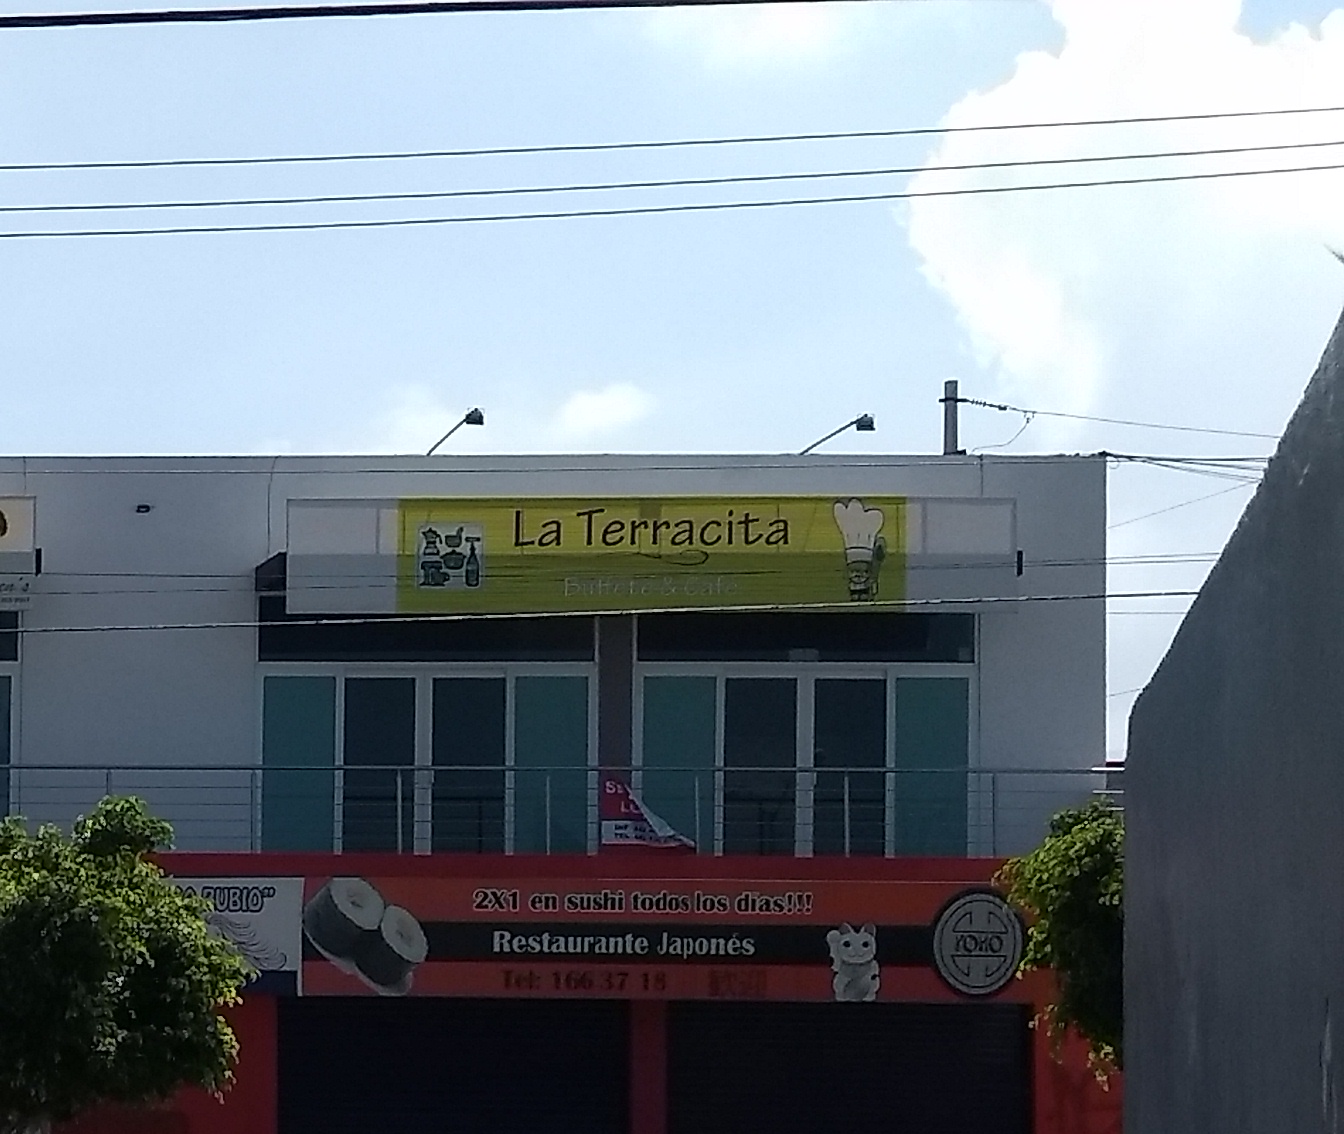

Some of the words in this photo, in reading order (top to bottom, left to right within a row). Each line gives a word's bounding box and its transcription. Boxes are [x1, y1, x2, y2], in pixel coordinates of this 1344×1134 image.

[513, 509, 563, 548] La
[574, 508, 792, 548] Terracita
[528, 892, 560, 911] en
[565, 890, 625, 913] sushi
[631, 891, 691, 914] todos
[693, 890, 729, 914] los
[491, 930, 651, 955] Restaurante
[656, 931, 757, 959] Japonés
